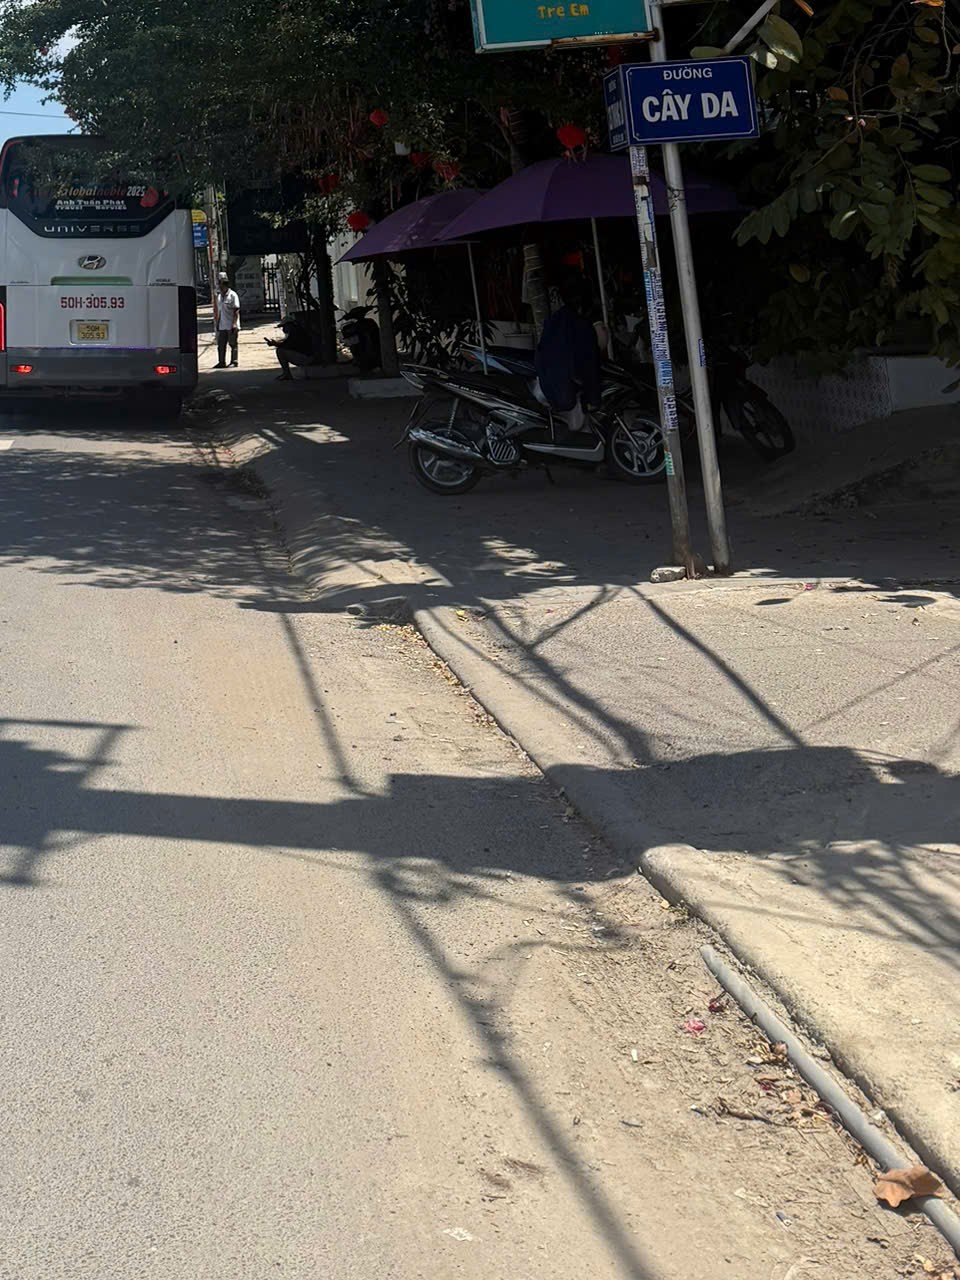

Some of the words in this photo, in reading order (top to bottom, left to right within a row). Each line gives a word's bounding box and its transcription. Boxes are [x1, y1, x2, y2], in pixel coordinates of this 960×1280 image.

[662, 65, 713, 81] ĐƯỜNG
[641, 88, 692, 123] CÂY
[700, 90, 739, 119] DA
[61, 296, 125, 309] 50H-305.93
[86, 324, 100, 332] 50H
